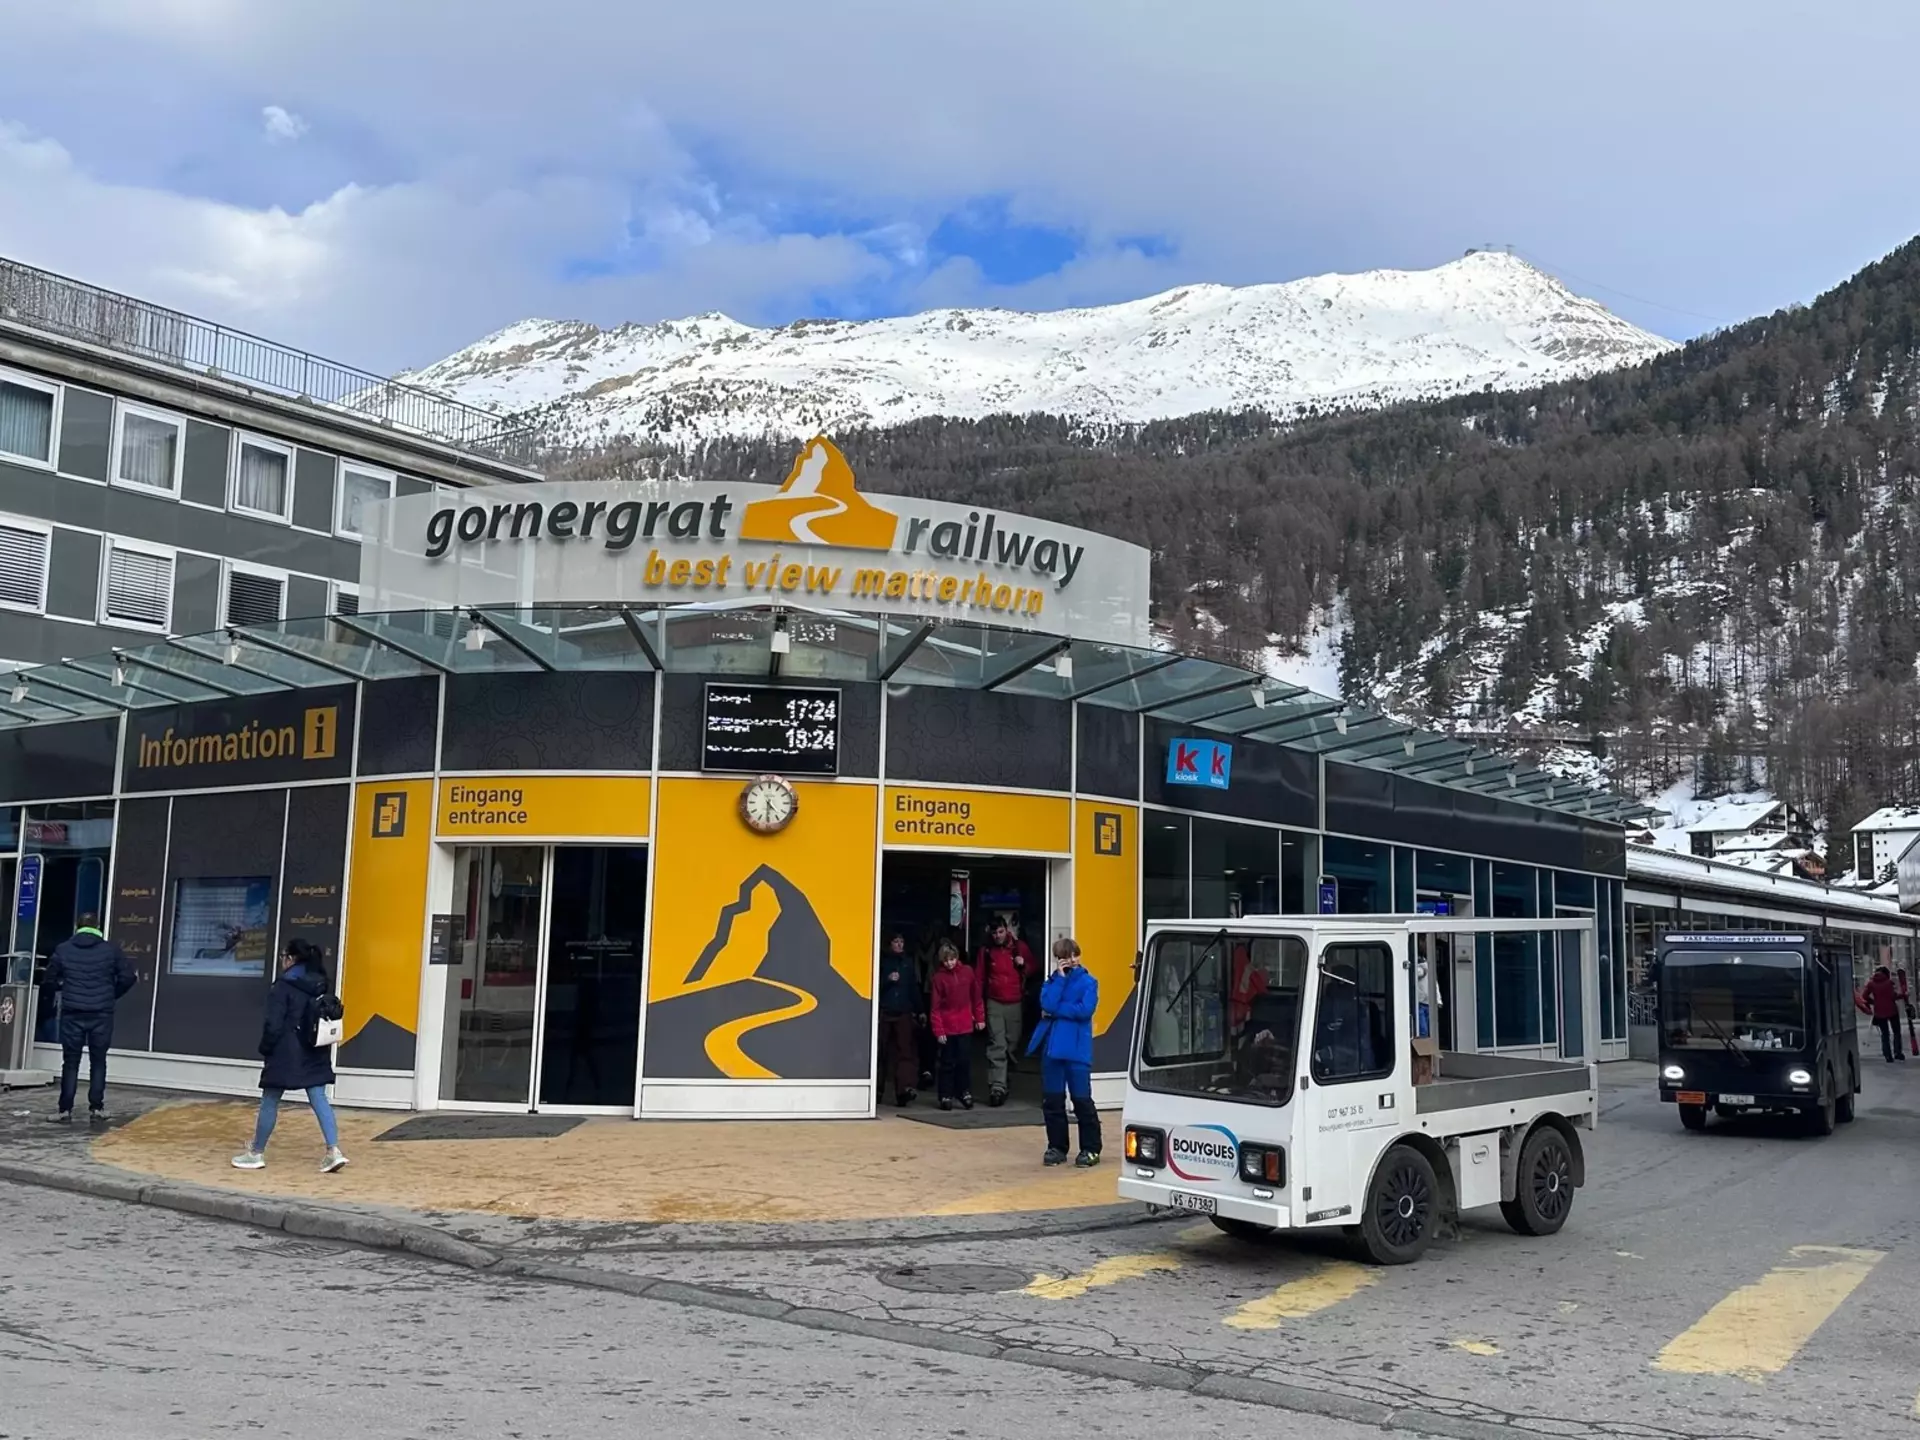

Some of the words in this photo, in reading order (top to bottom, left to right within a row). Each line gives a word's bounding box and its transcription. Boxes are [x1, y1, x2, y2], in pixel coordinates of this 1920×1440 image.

[425, 494, 732, 558] gornergrat
[906, 511, 1084, 589] railway
[642, 549, 732, 587] best
[744, 553, 842, 592] view
[852, 568, 1044, 614] matterhorn
[786, 698, 836, 721] 17:24
[138, 720, 296, 768] Information
[1175, 772, 1199, 781] kiosk
[450, 785, 523, 807] Eingang
[895, 794, 971, 819] Eingang
[448, 809, 528, 824] entrance
[894, 818, 976, 837] entrance
[1172, 1138, 1235, 1160] BOUYGUES
[1173, 1152, 1202, 1164] ENERGIES
[1206, 1158, 1235, 1169] SERVICES
[1172, 1193, 1183, 1206] VS
[1187, 1197, 1213, 1212] 67382
